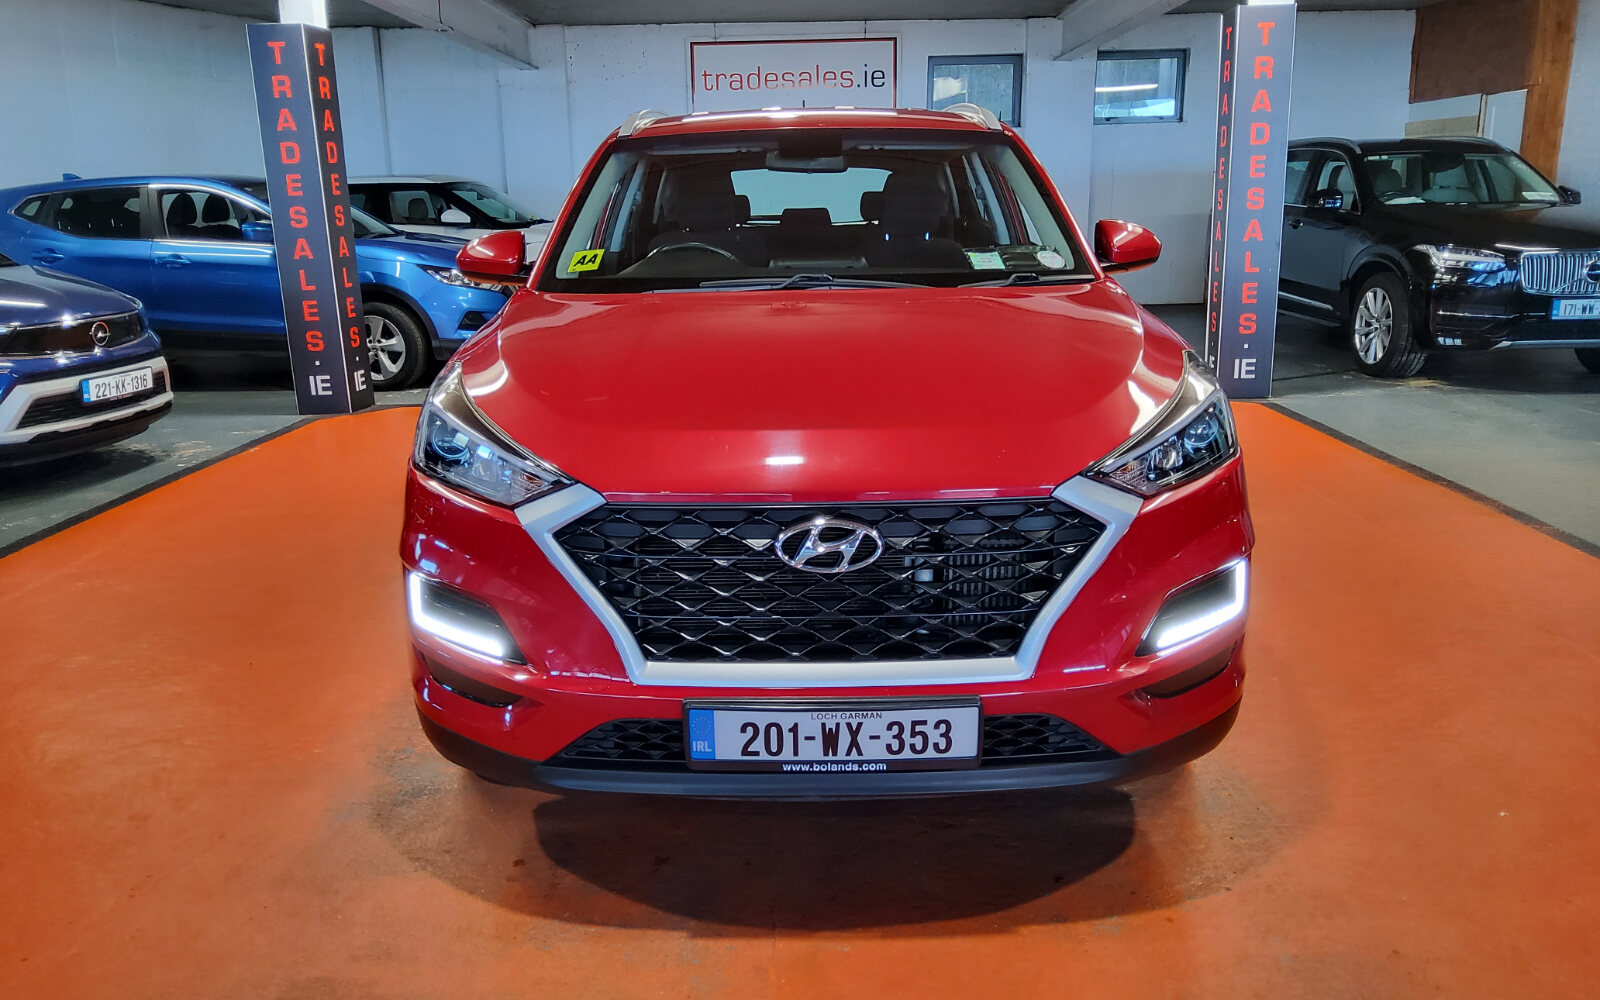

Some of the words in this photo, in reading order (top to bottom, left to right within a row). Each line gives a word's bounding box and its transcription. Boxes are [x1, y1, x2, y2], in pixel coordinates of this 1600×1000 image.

[702, 63, 886, 91] tradesales.ie
[573, 253, 599, 267] AA
[94, 374, 148, 399] 221-KK-1316
[810, 712, 838, 720] LOCH
[840, 712, 883, 720] GARMAN
[739, 718, 954, 757] 201-WX-353
[692, 740, 712, 752] IRL
[782, 762, 887, 772] www.bolands.com
